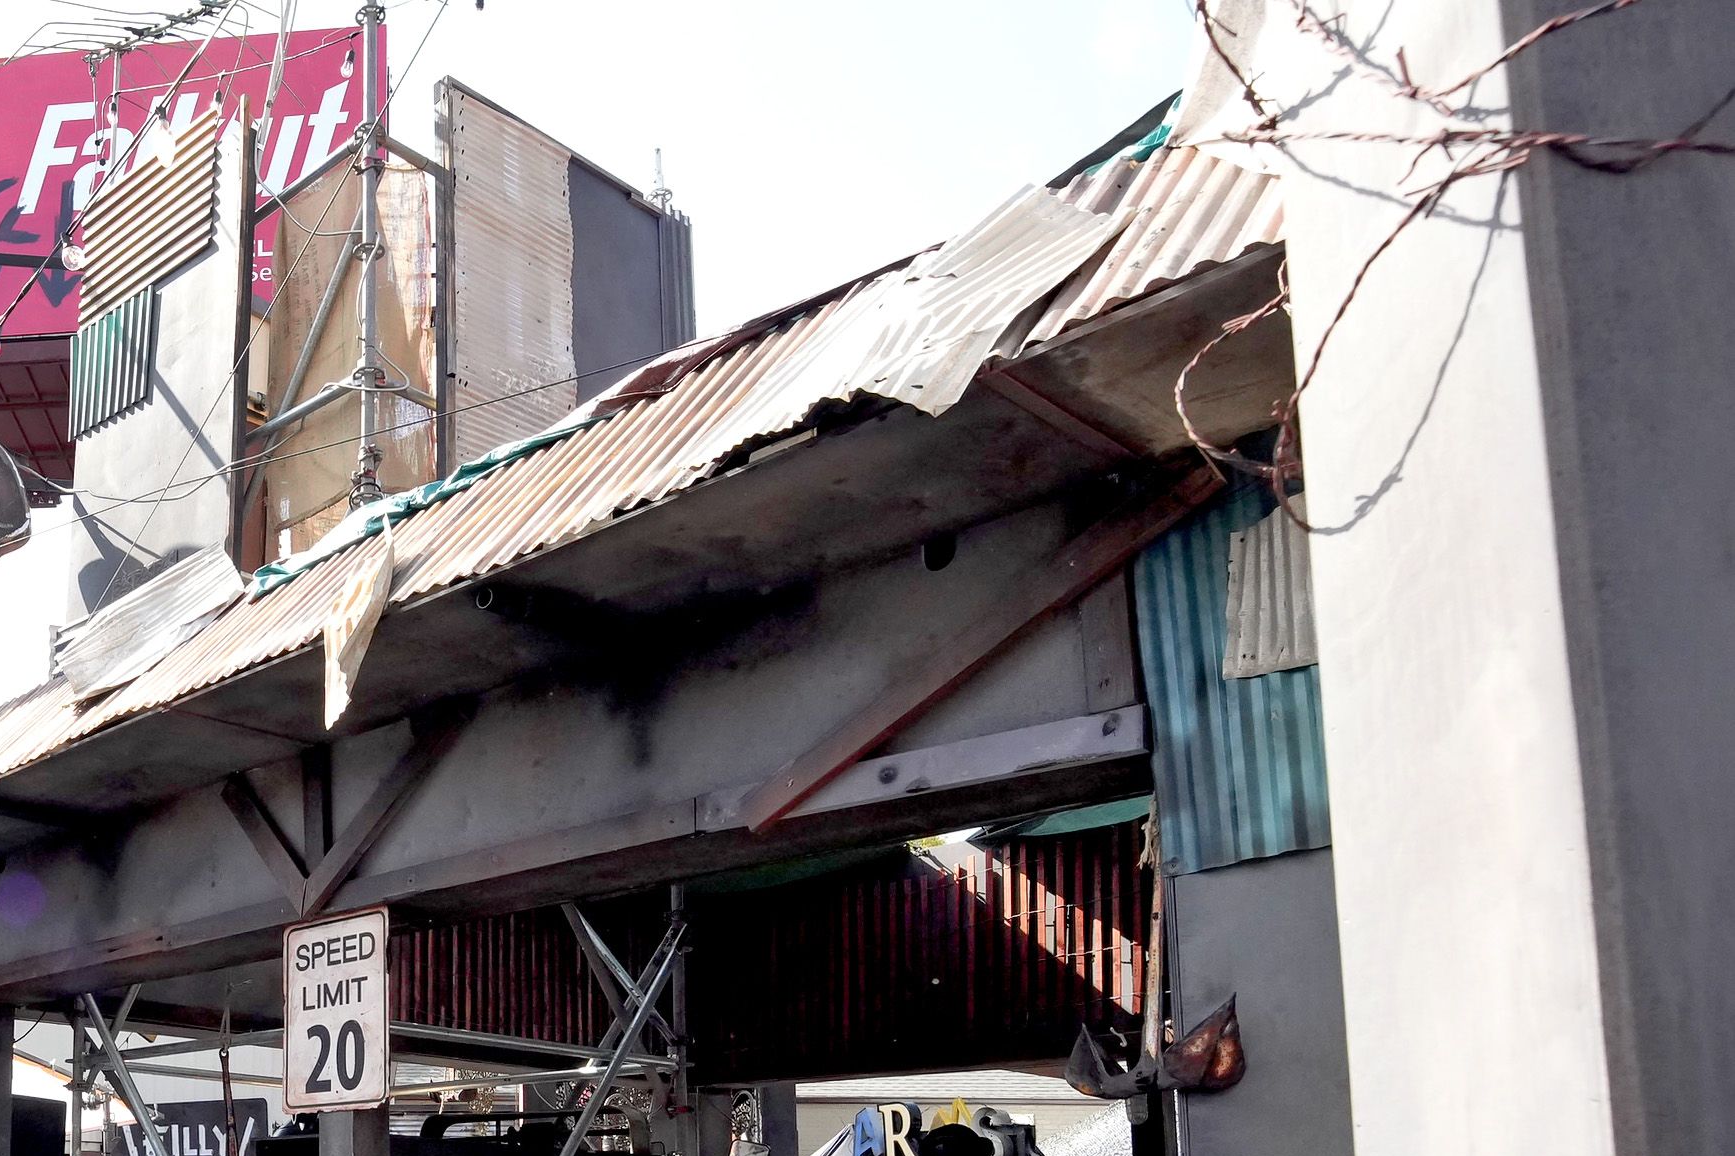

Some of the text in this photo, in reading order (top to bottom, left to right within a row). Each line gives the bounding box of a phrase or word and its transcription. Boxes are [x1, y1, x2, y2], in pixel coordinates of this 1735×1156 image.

[20, 80, 349, 214] Falut
[295, 931, 376, 972] SPEED
[302, 976, 369, 1011] LIMIT
[305, 1019, 365, 1094] 20
